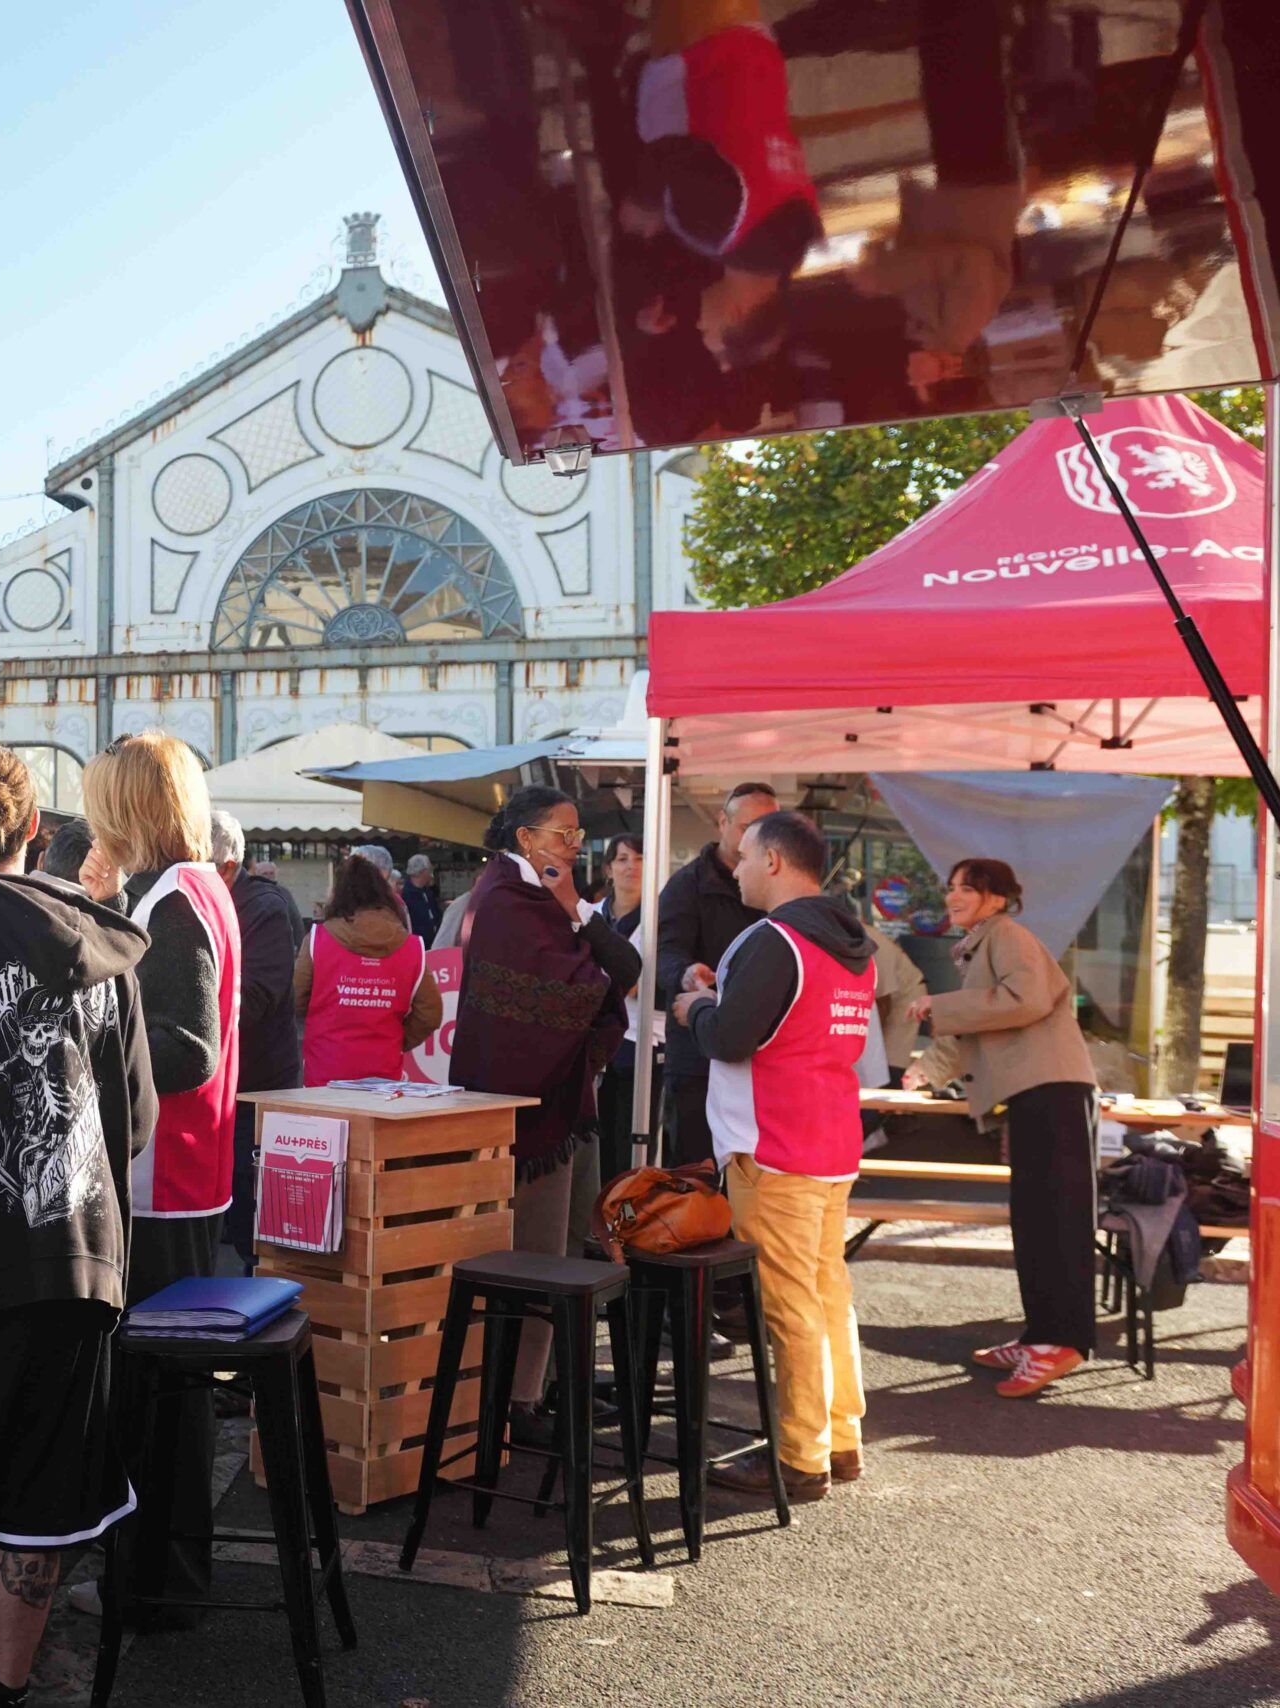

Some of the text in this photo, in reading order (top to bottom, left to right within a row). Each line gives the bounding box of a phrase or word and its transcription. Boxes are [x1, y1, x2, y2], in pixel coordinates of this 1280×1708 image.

[997, 543, 1099, 566] RÉGION
[340, 975, 357, 983] Une
[358, 977, 391, 986] question
[337, 985, 396, 997] Venez à ma
[339, 997, 392, 1009] rencontre
